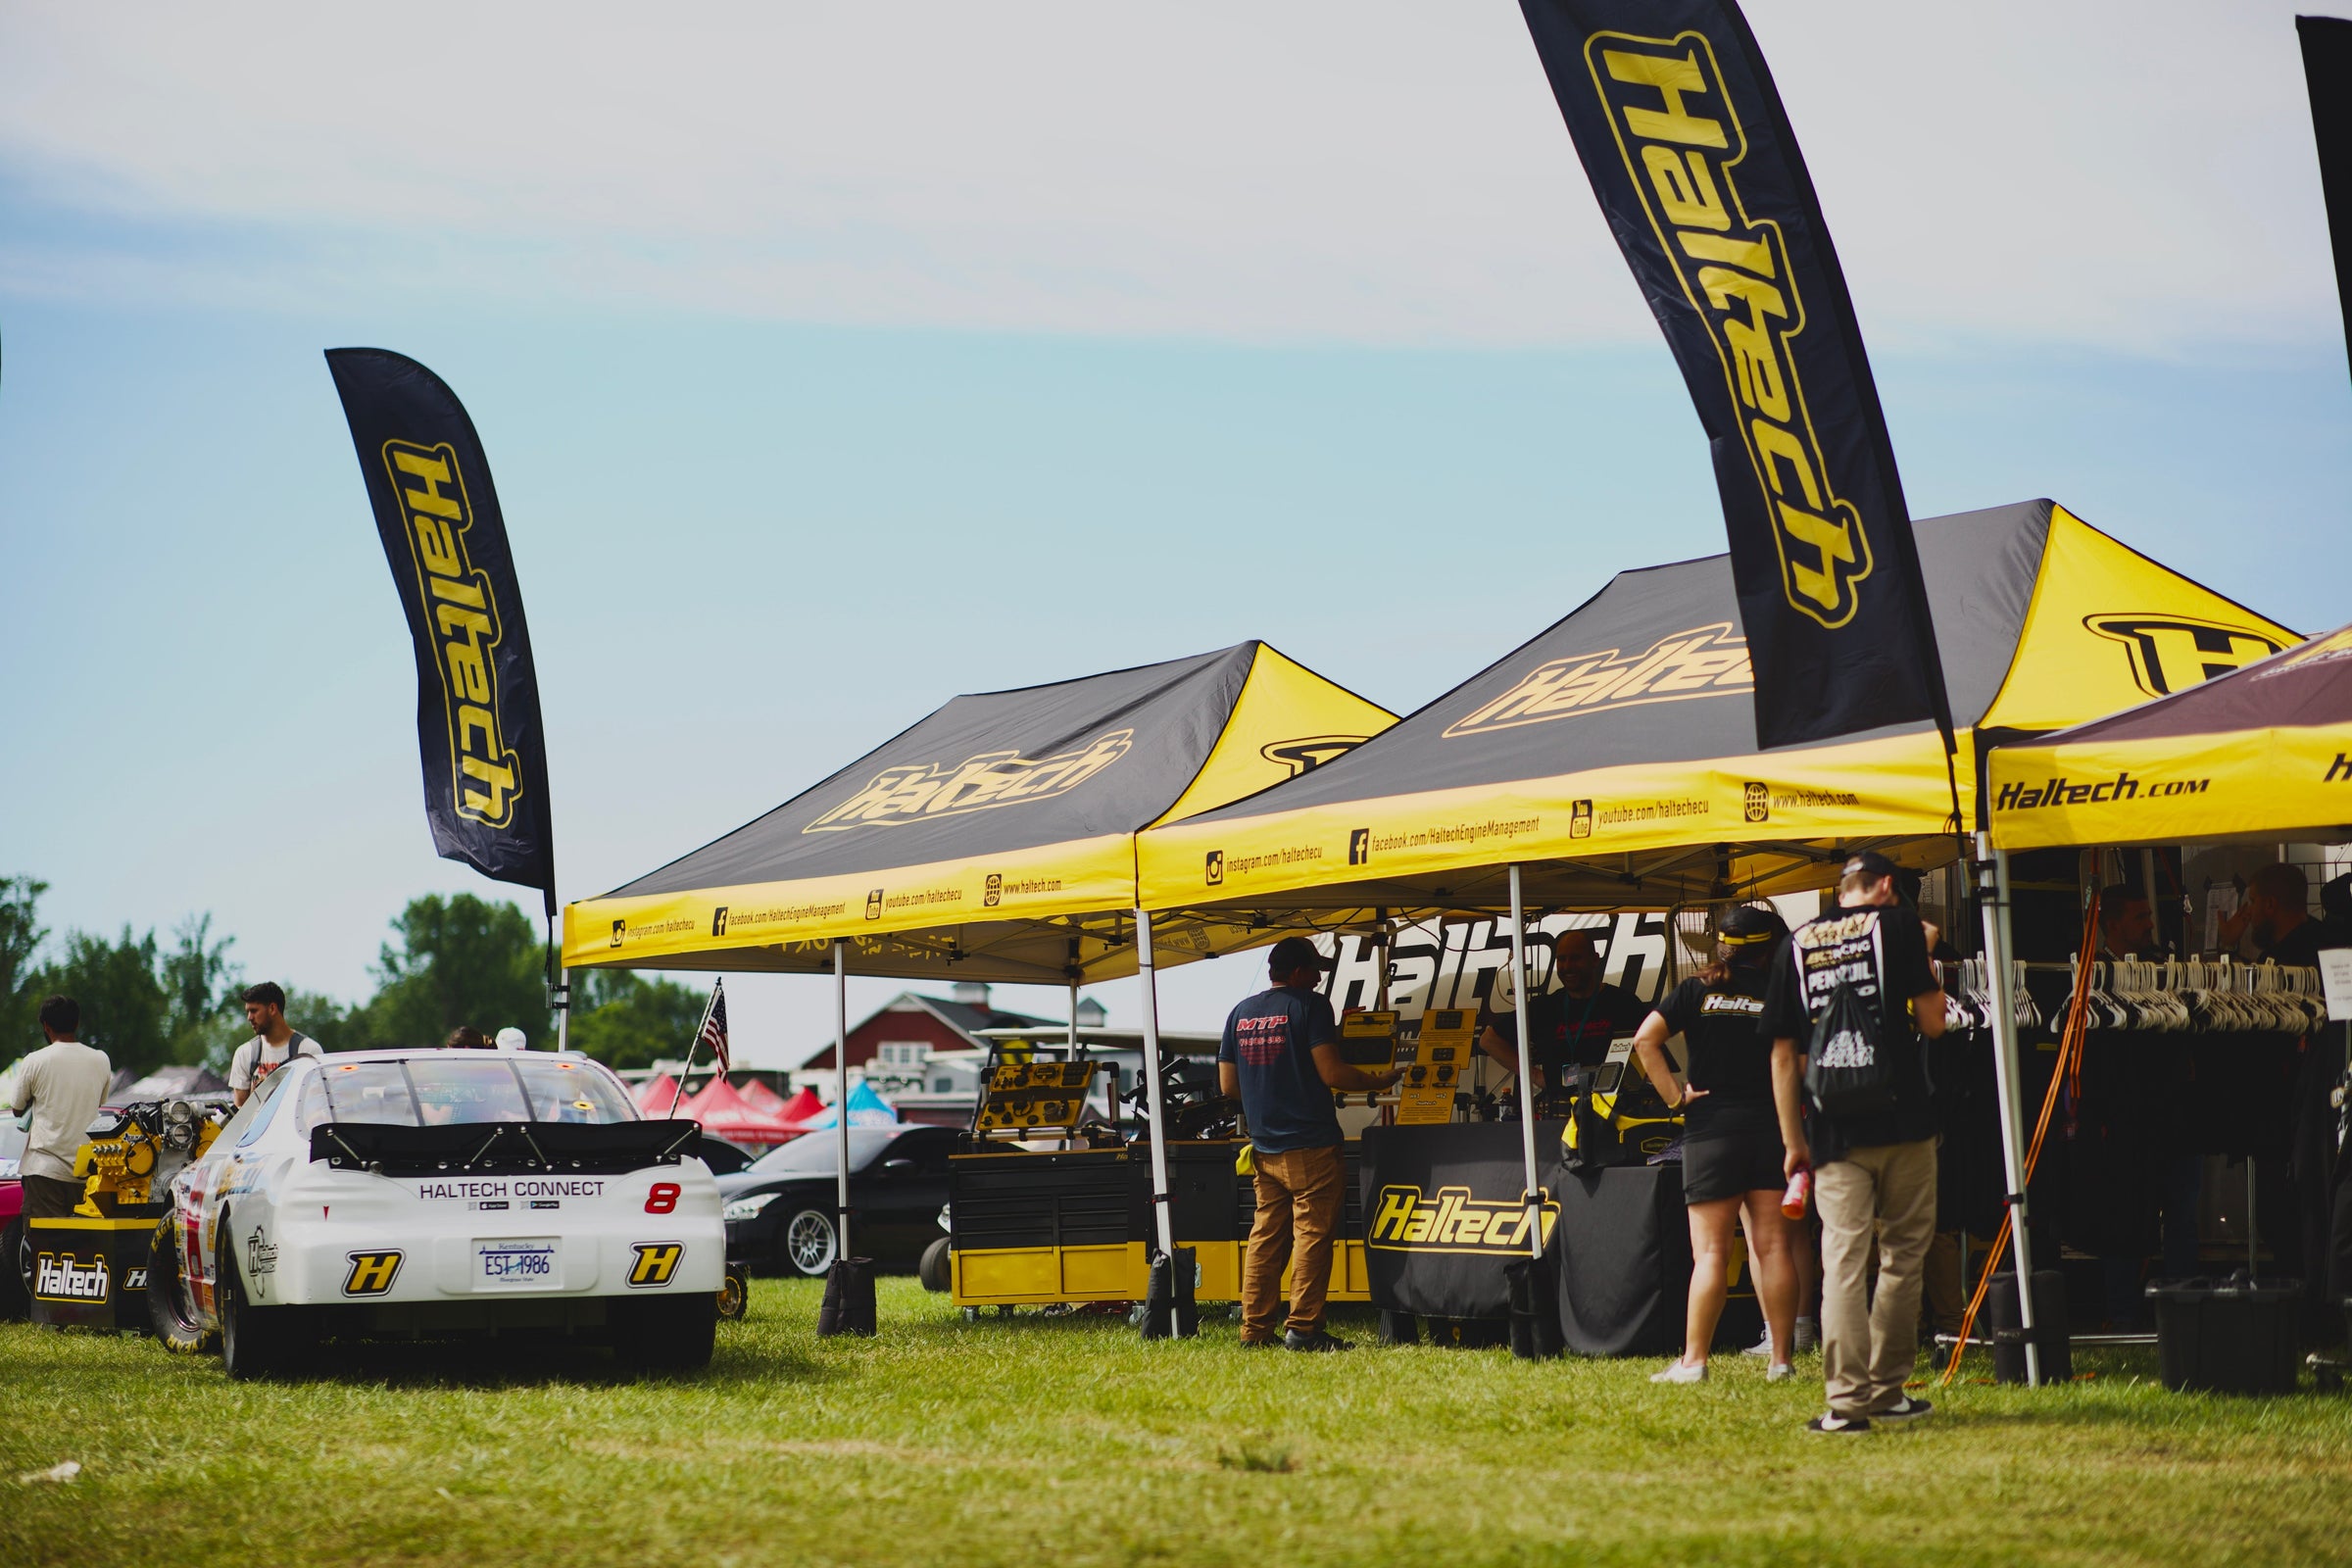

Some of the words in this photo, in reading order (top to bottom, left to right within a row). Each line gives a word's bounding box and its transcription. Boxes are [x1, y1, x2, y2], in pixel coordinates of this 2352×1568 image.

[1601, 47, 1857, 612] Haltech
[391, 449, 516, 821] Haltech
[1457, 632, 1755, 728] Halte
[815, 735, 1131, 826] Haltech
[1598, 800, 1709, 829] youtube.com/haltechecu
[1773, 791, 1860, 809] www.haltech.com
[1372, 816, 1541, 852] facebook.com/HaltechEngineManagement
[1226, 845, 1323, 874] instagram.com/haltechecu
[885, 889, 962, 911] youtube.com/haltechecu
[1004, 878, 1061, 896] www.haltech.com
[728, 902, 846, 926] facebook.com/HaltechEngineManagement
[627, 919, 695, 940] instagram.com/haltechecu
[1703, 996, 1765, 1012] Halte
[1236, 1015, 1289, 1031] MTP
[420, 1183, 507, 1199] HALTECH
[514, 1181, 605, 1197] CONNECT
[644, 1182, 682, 1214] 8
[150, 1214, 174, 1253] EAGL
[498, 1243, 535, 1251] Kentucky
[36, 1258, 109, 1298] Haltech
[345, 1252, 402, 1295] H
[485, 1255, 512, 1275] EST
[518, 1254, 551, 1275] 1986
[628, 1244, 682, 1285] H
